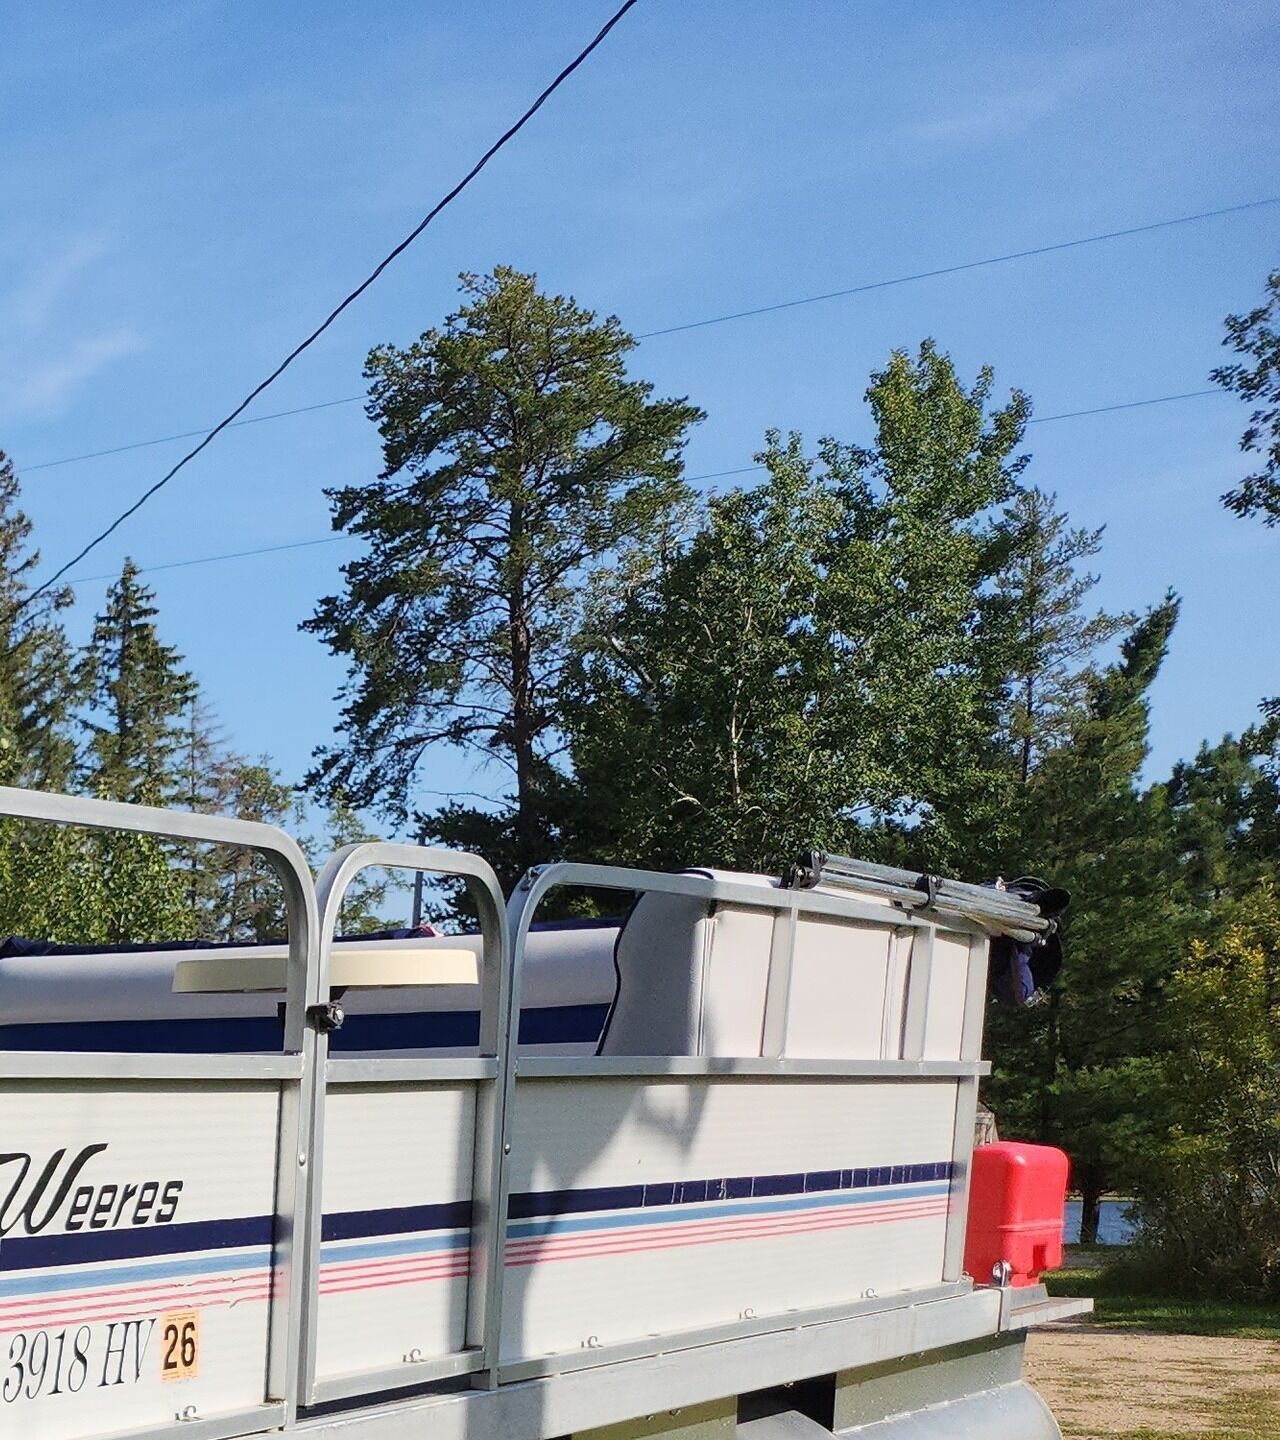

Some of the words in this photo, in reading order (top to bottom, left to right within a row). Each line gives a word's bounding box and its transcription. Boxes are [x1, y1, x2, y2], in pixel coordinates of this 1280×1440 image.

[3, 1325, 90, 1403] 3918
[97, 1318, 157, 1387] HV
[163, 1321, 196, 1370] 26
